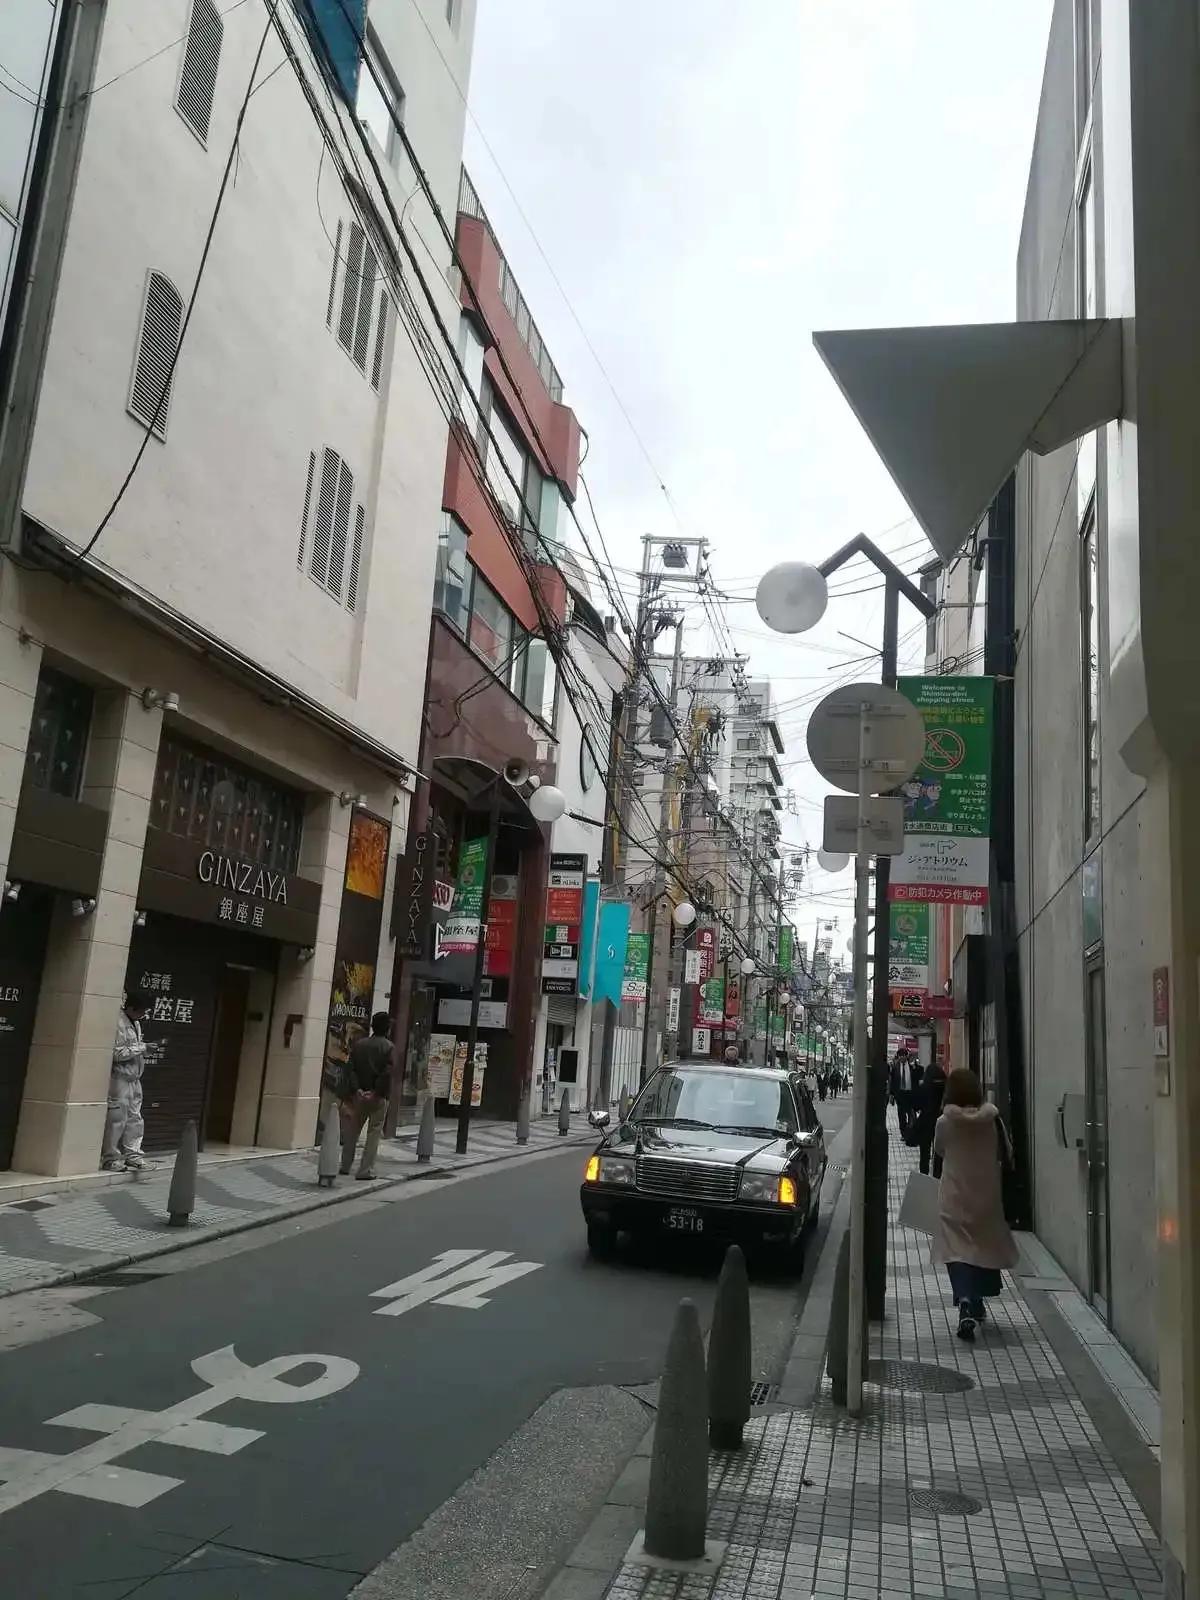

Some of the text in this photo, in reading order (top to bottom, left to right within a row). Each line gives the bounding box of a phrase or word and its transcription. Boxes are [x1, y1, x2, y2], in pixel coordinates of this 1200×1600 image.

[198, 851, 289, 906] GINZAYA
[405, 836, 428, 943] GINZAYA
[908, 887, 982, 900] 防犯カメラ作動中
[218, 896, 265, 929] 銀座屋
[669, 1215, 704, 1232] 53-18
